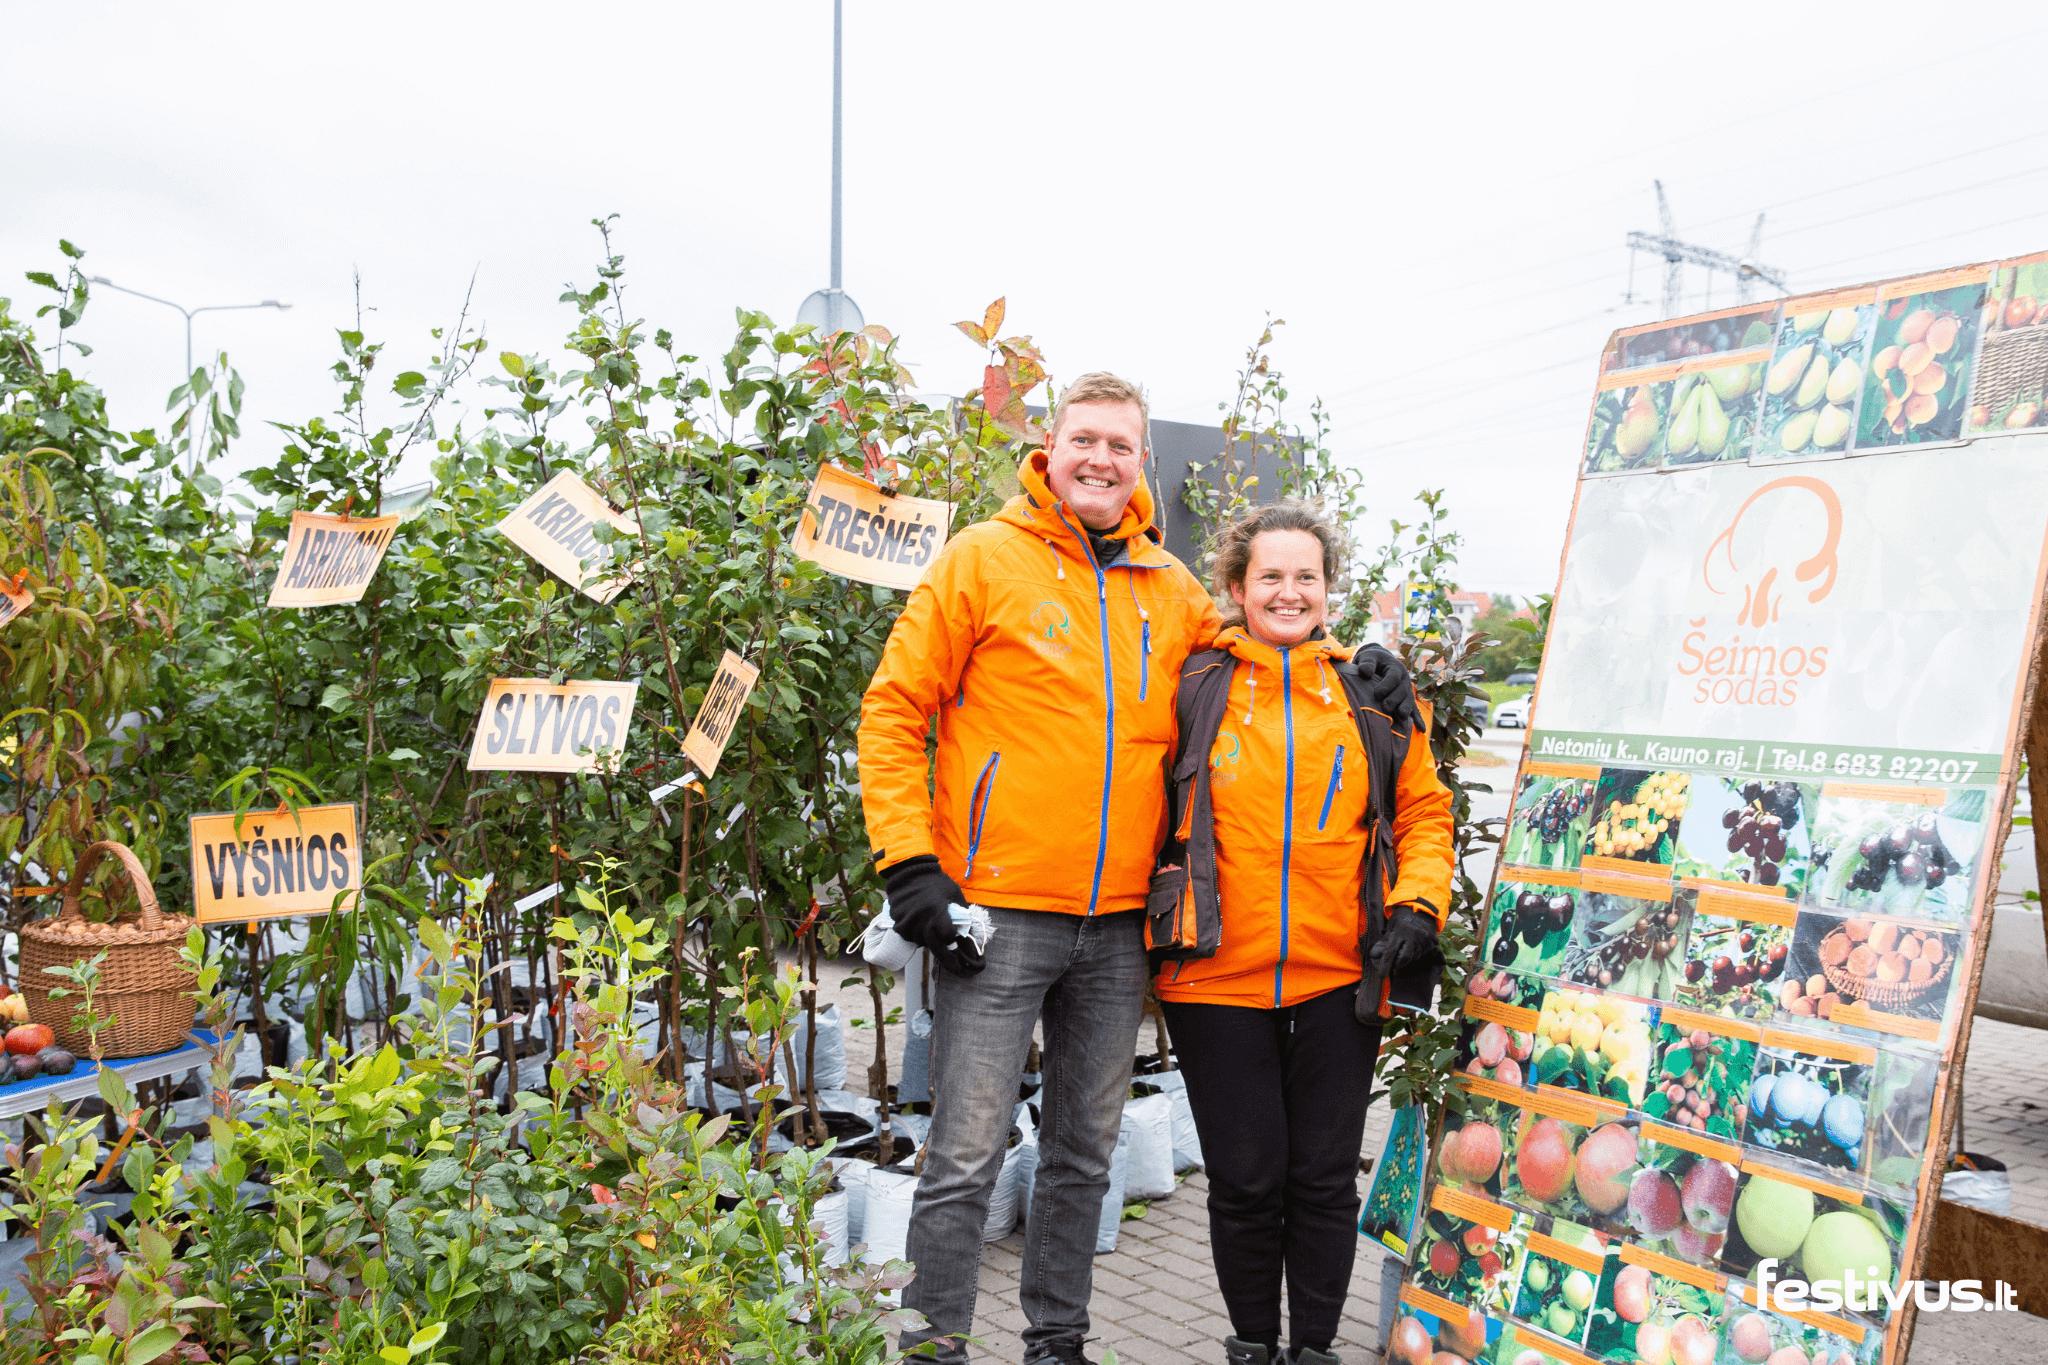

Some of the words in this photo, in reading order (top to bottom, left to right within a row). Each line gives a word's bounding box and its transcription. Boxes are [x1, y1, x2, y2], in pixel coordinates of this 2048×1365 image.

[283, 527, 391, 589] ABRIKOSAI
[812, 494, 937, 567] TREŠNĖS
[1677, 616, 1829, 678] Šeimos
[697, 668, 748, 749] OBELYS
[1693, 674, 1798, 706] sodas
[486, 692, 621, 756] SLYVOS
[1541, 736, 1612, 761] Netonių
[1644, 741, 1709, 765] Kauno
[1714, 746, 1748, 771] raj.
[1834, 752, 1883, 777] 683
[1888, 755, 1979, 784] 82207
[204, 825, 350, 900] VYŠNIOS
